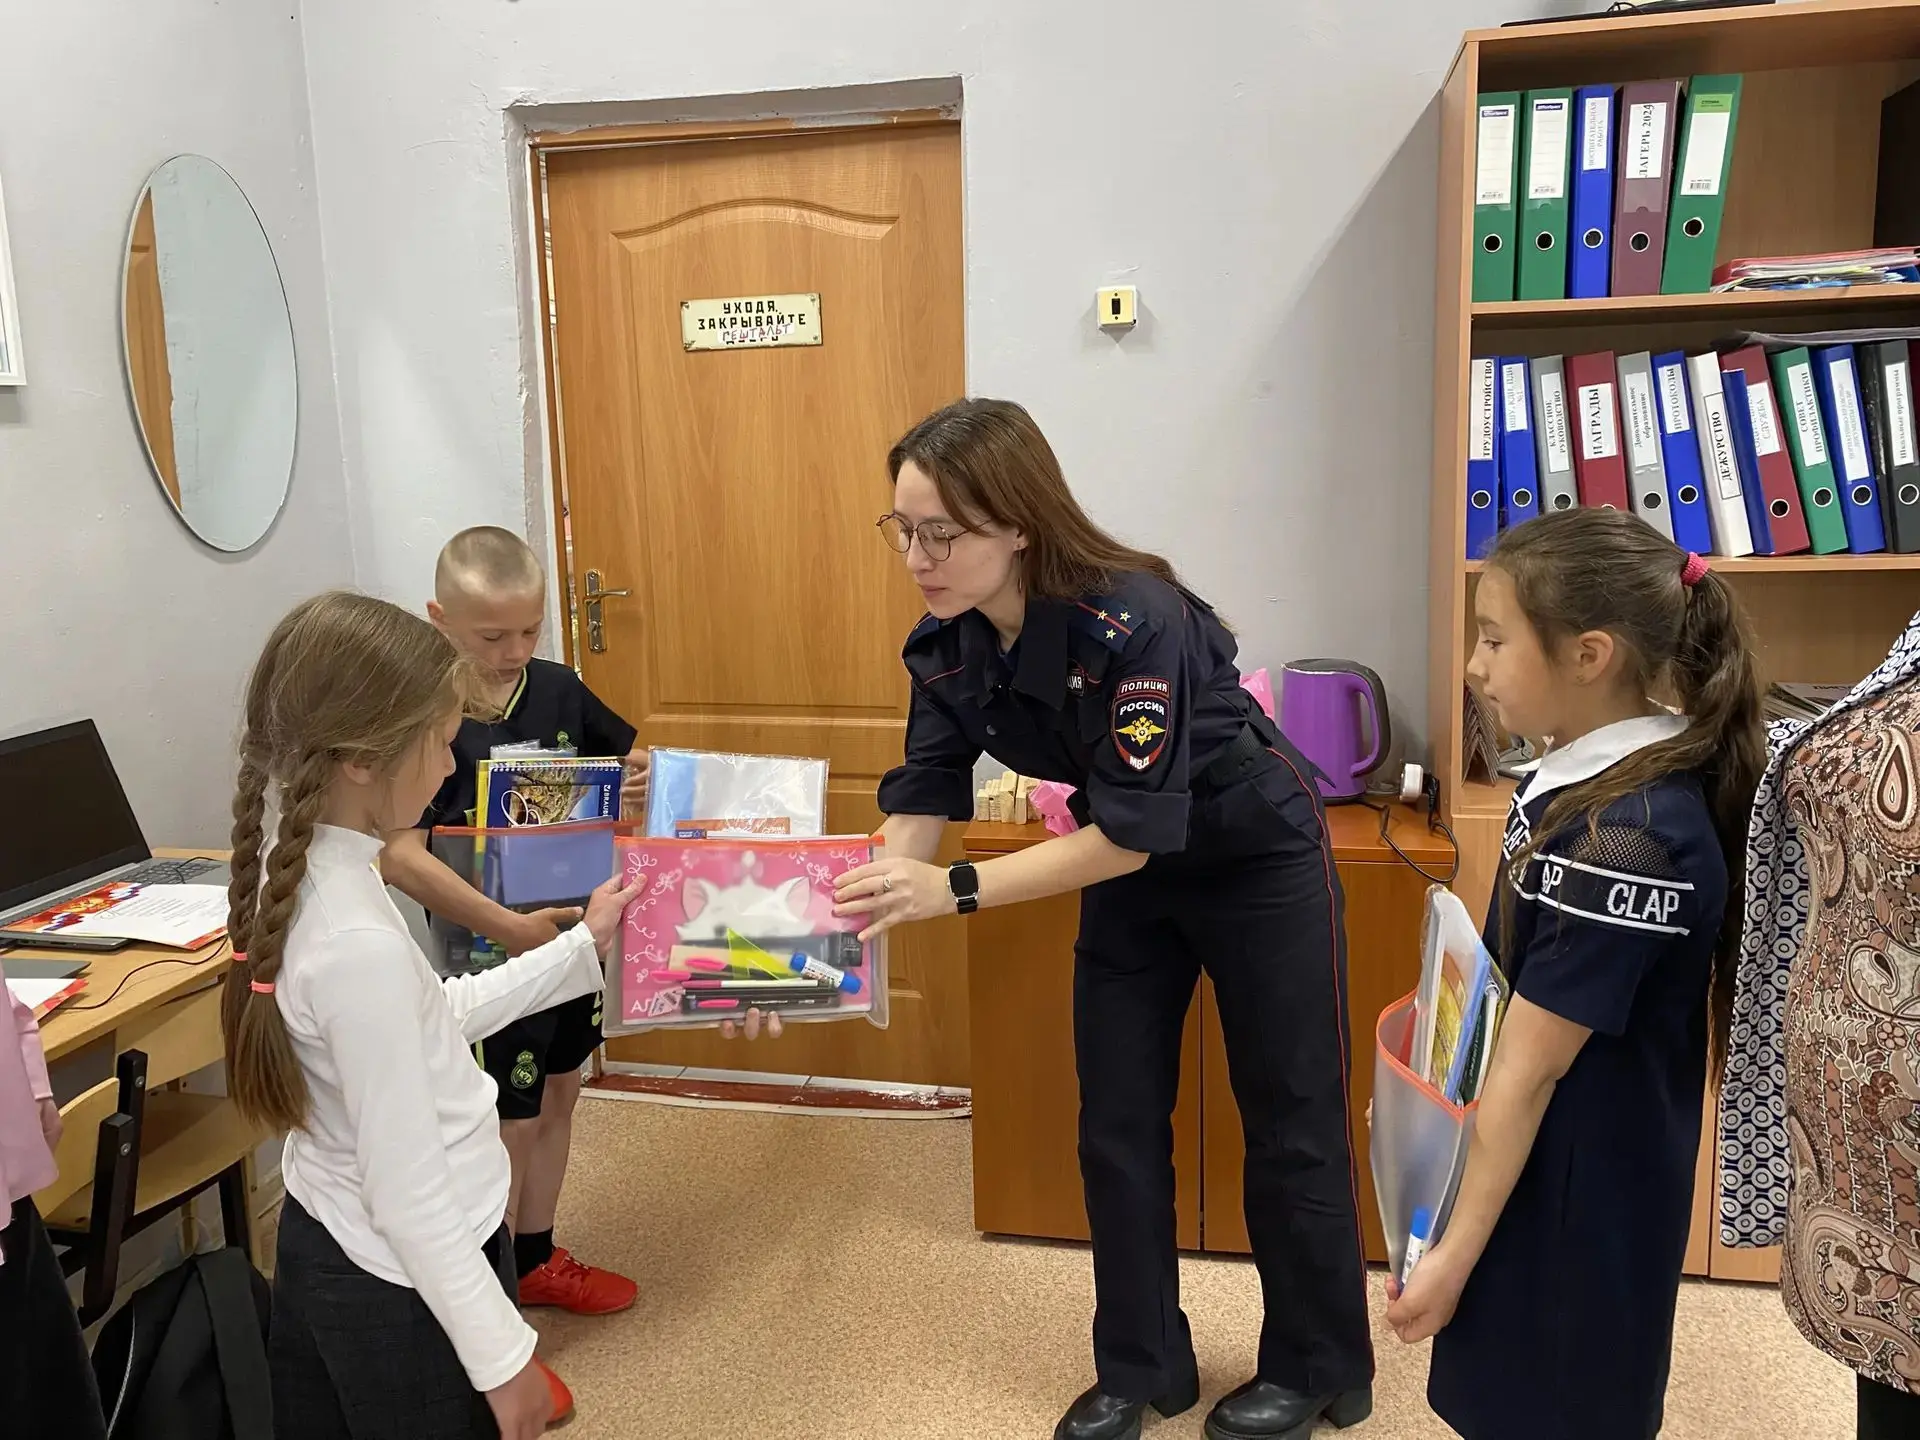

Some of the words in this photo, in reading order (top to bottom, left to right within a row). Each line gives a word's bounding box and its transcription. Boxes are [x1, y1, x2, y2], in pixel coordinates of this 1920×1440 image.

[1639, 130, 1651, 179] ЛАГЕРЬ
[698, 312, 806, 330] ЗАКРЫВАЙТЕ
[722, 323, 791, 341] ГЕШТАЛЬТ
[1482, 360, 1493, 458] ТРУДОУСТРОЙСТВО
[1639, 392, 1652, 440] образование
[1667, 367, 1682, 430] ПРОТОКОЛЫ
[1801, 371, 1824, 453] ПРОФИЛАКТИКИ
[1893, 369, 1904, 415] программы
[1545, 399, 1557, 449] КЛАССНОЕ
[1553, 390, 1567, 455] РУКОВОДСТВО
[1588, 388, 1603, 455] НАГРАДЫ
[1629, 387, 1643, 449] Дополнительное
[1795, 400, 1809, 434] СОВЕТ
[1898, 416, 1907, 460] Школьные
[1711, 411, 1733, 482] ДЕЖУРСТВО
[1119, 701, 1165, 716] РОССИЯ
[1121, 680, 1168, 694] ПОЛИЦИЯ
[1129, 755, 1150, 770] МВД
[1606, 882, 1681, 924] CLAP
